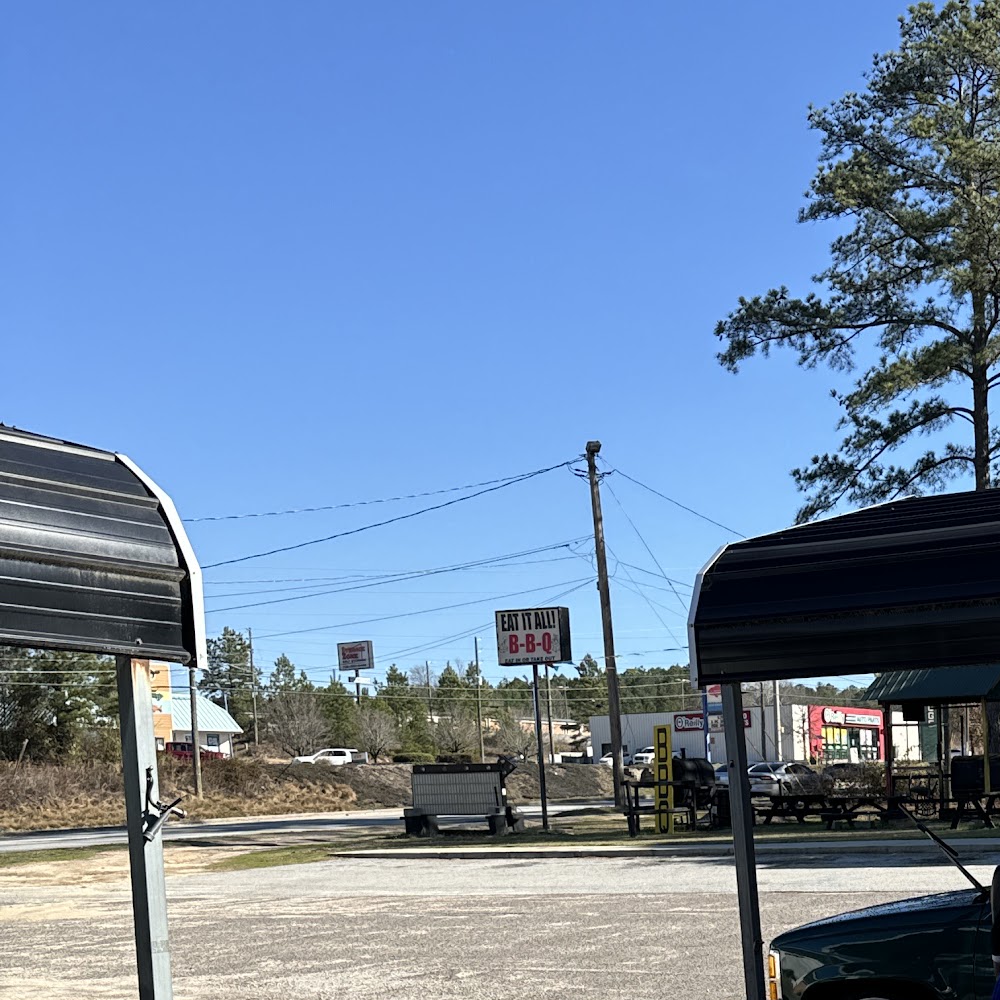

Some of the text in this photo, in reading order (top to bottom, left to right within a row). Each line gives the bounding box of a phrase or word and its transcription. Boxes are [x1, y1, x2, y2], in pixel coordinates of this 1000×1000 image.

[501, 611, 555, 631] EAT IT ALL!
[509, 632, 552, 654] B-B-Q
